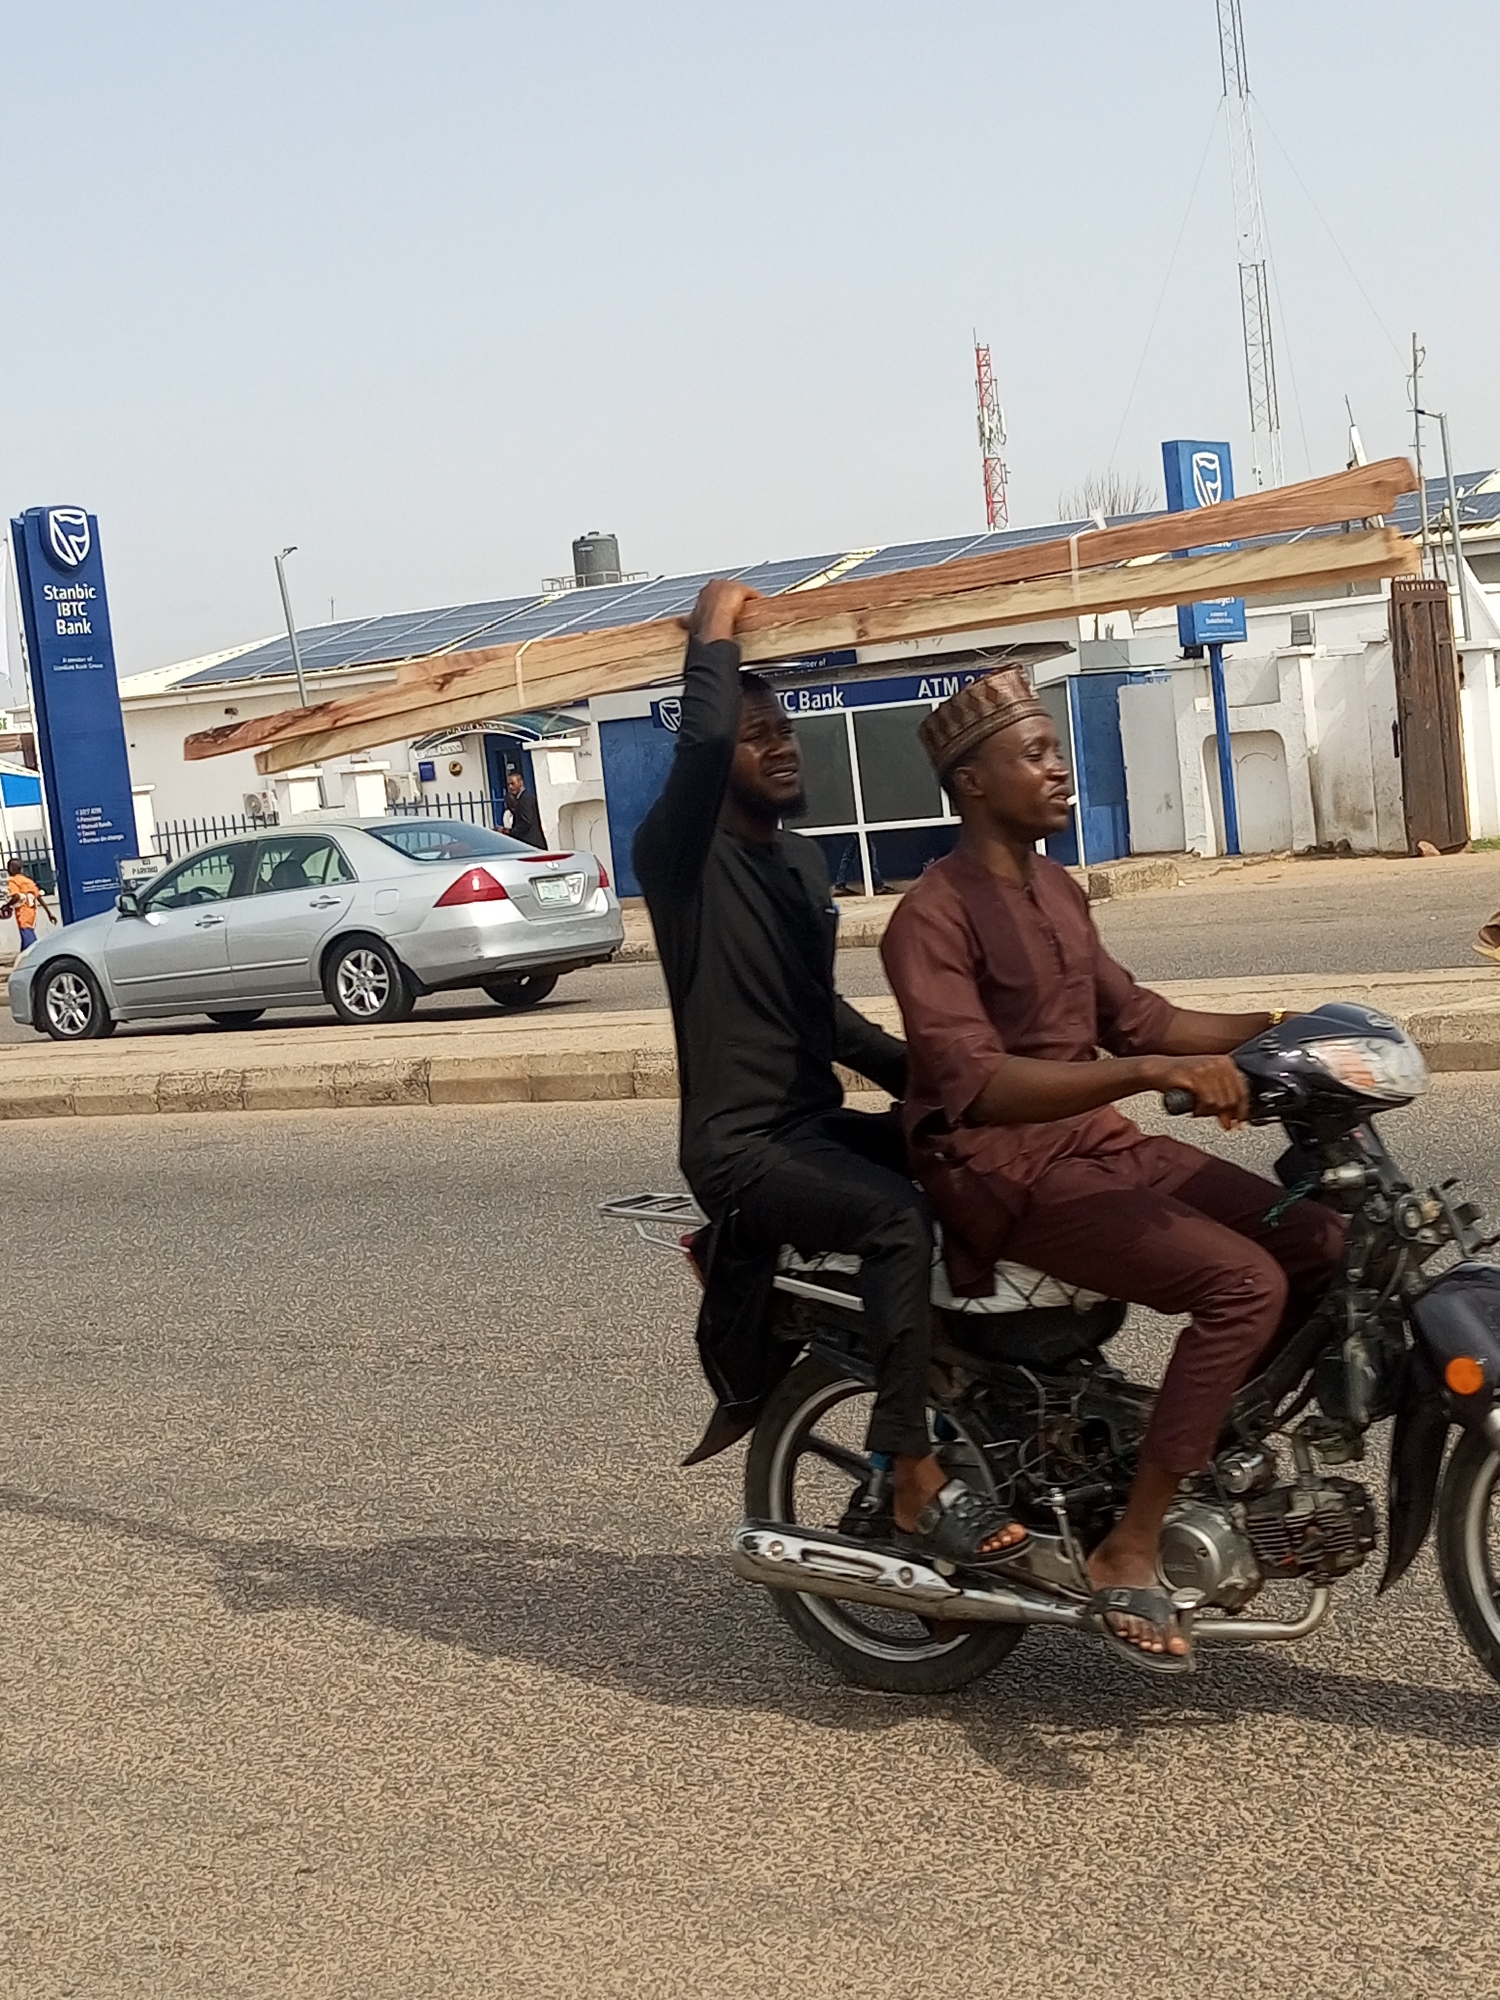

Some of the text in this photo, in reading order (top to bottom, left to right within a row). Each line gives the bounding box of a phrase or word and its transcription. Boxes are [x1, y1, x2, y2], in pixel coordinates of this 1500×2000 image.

[43, 583, 98, 600] Stanbic
[57, 601, 88, 617] IBTC
[55, 617, 92, 635] Bank
[775, 690, 797, 711] TC
[798, 686, 844, 710] Bank
[918, 676, 960, 698] ATM
